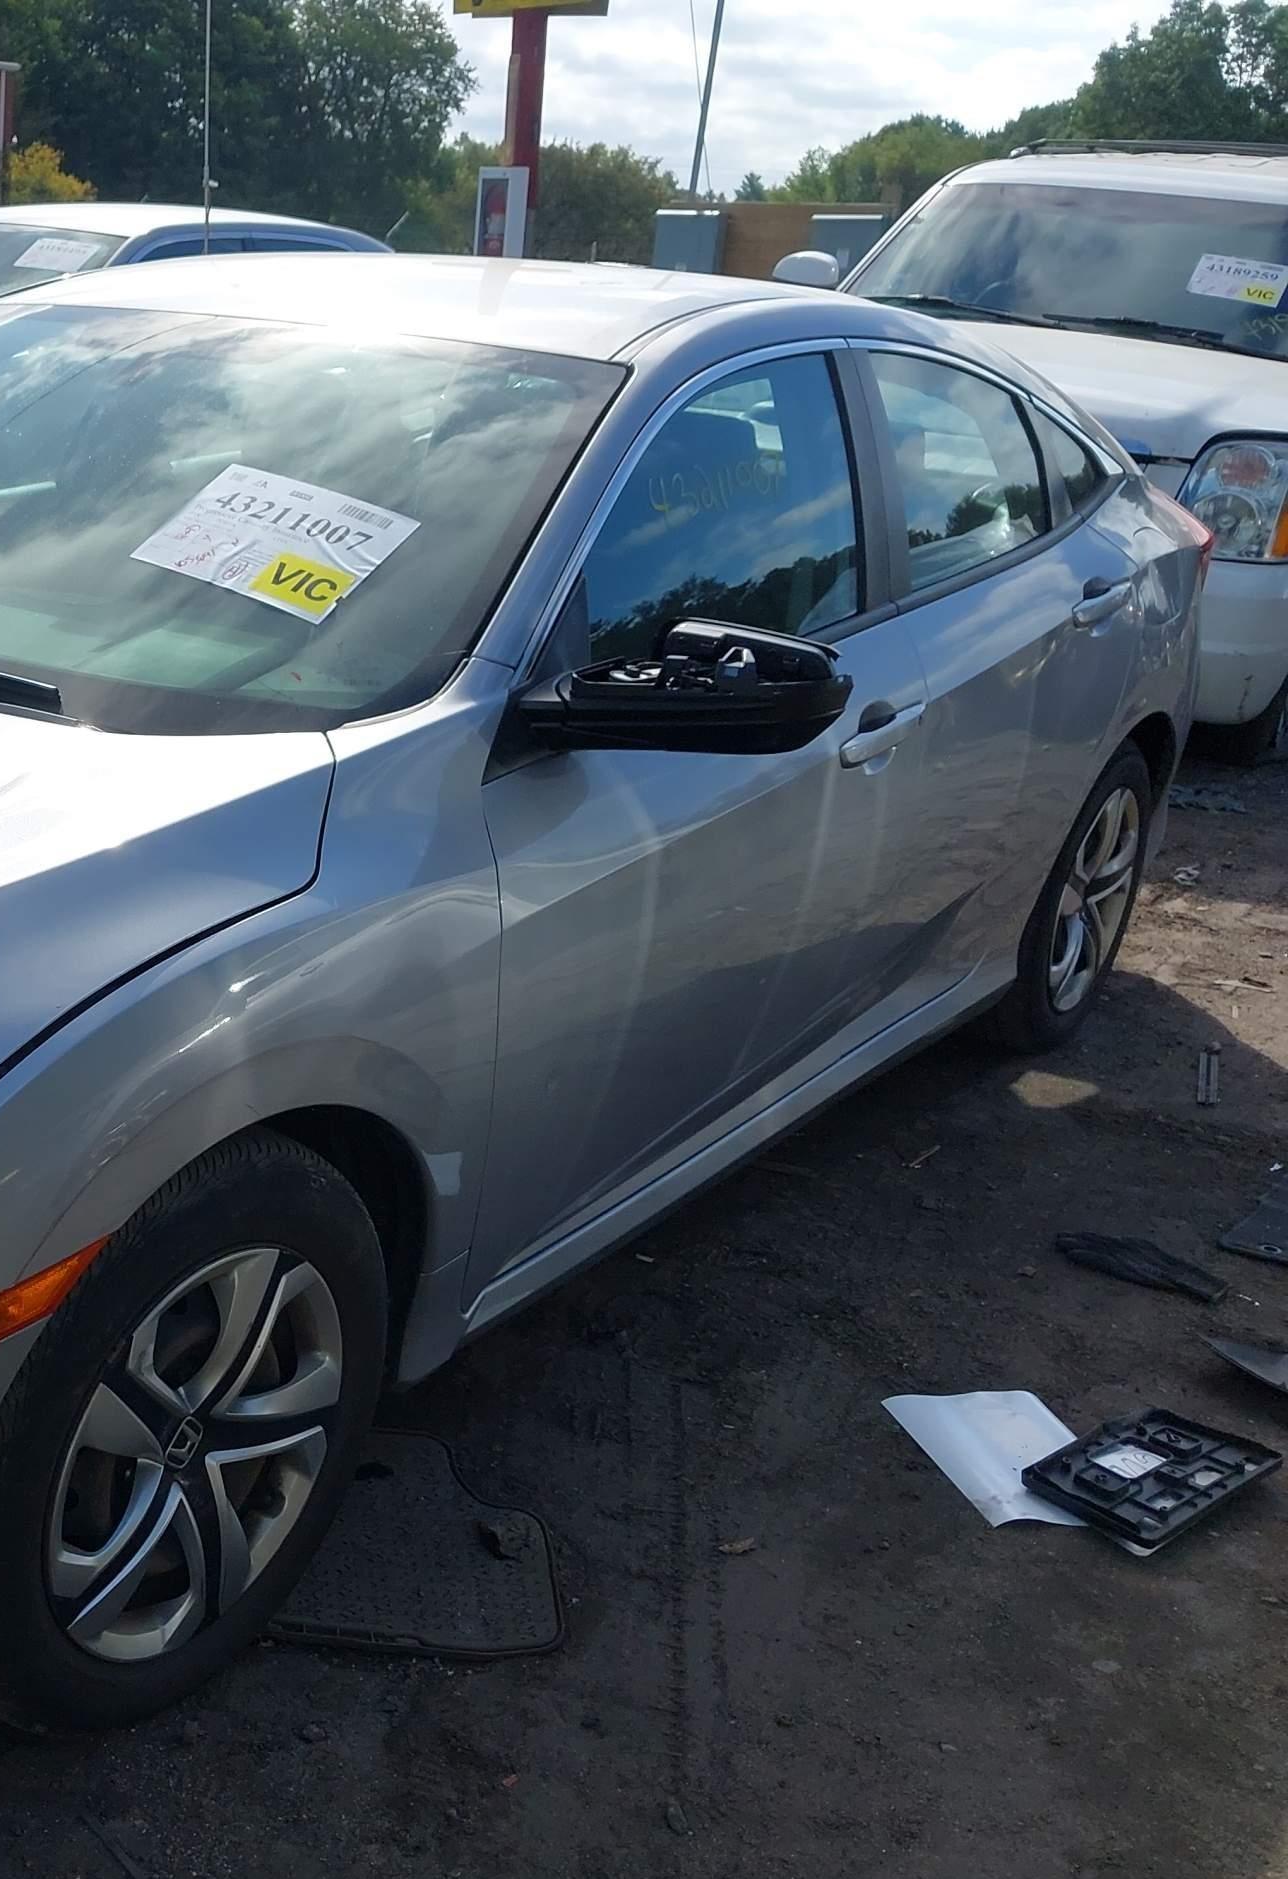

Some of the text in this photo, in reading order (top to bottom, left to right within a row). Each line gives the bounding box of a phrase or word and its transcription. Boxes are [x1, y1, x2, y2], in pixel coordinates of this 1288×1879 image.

[1206, 262, 1279, 281] 43189259
[1246, 287, 1275, 300] VIC
[215, 491, 374, 552] 43211007
[271, 562, 337, 602] VIC
